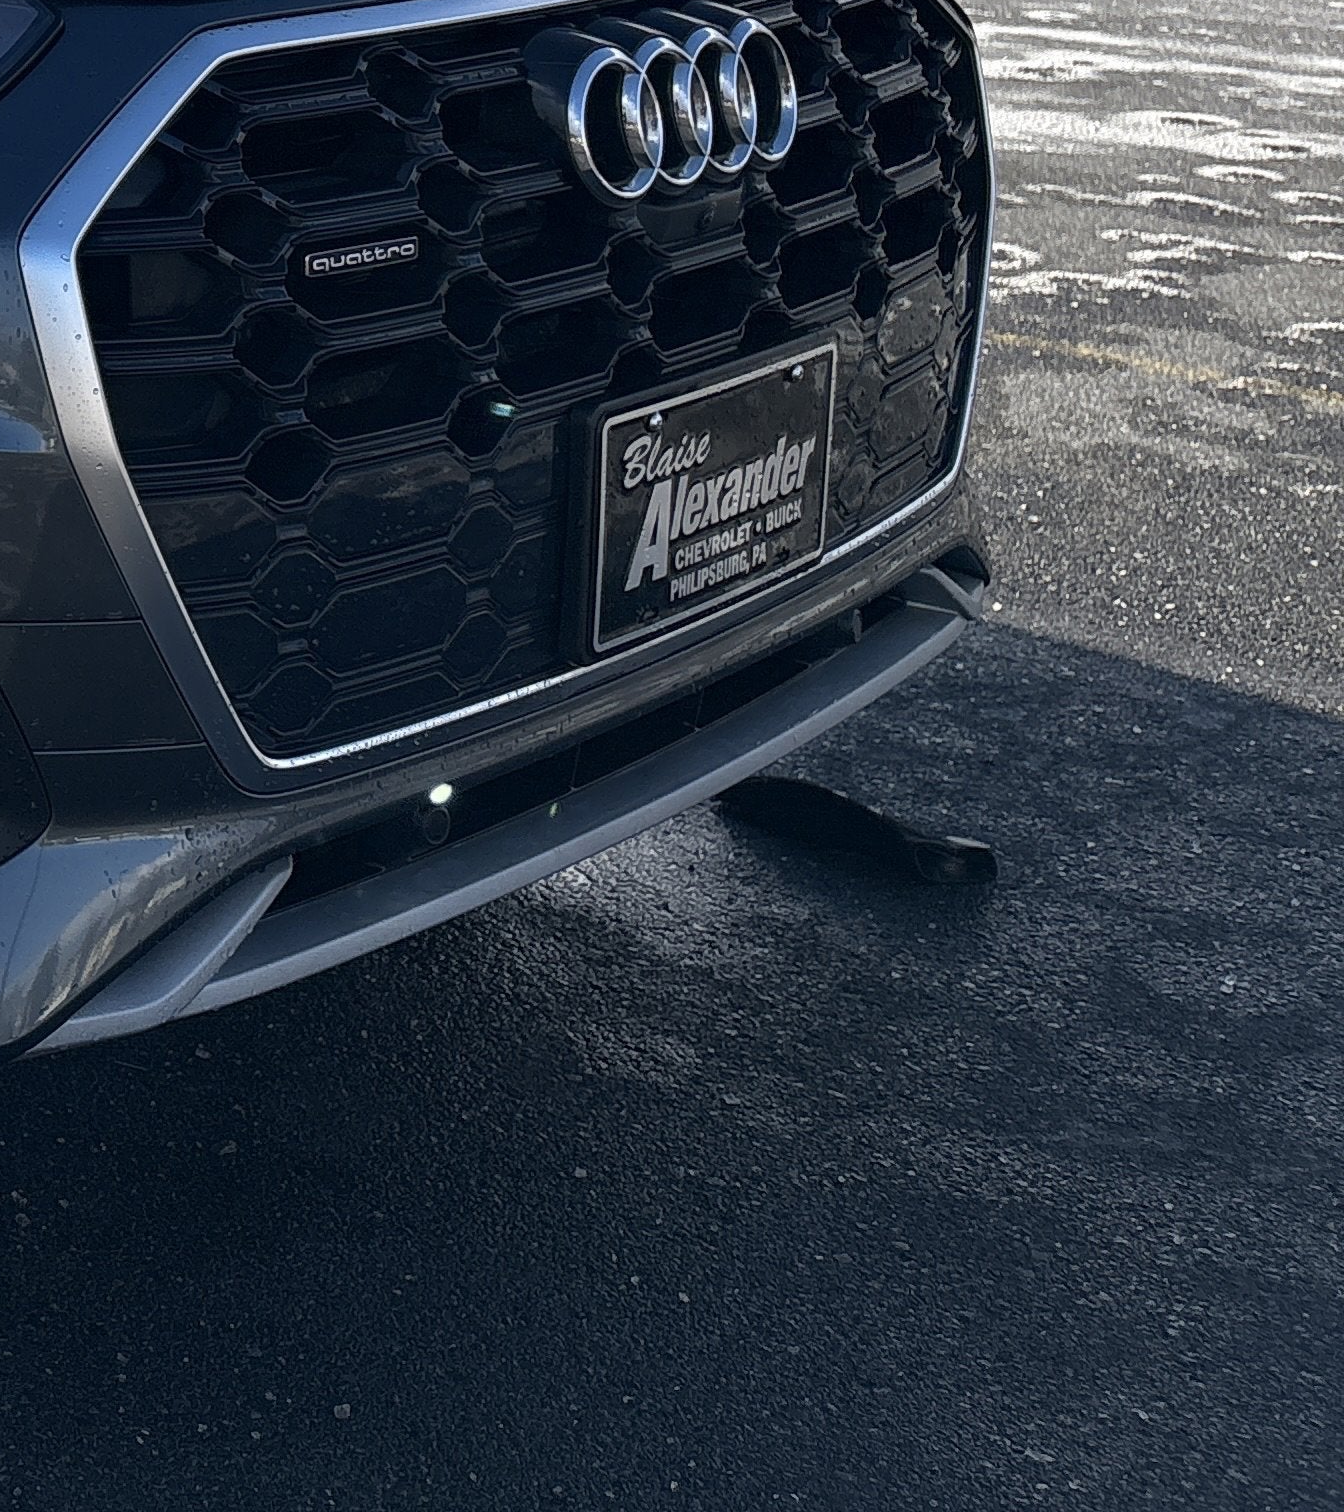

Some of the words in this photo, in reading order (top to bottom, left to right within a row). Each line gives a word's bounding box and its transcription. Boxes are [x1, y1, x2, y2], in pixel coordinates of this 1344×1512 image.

[312, 243, 415, 271] quattro
[623, 432, 711, 489] Blaise
[624, 435, 816, 592] Alexander
[674, 520, 752, 571] CHEVROLET
[765, 497, 803, 534] BUICK
[669, 551, 751, 602] PHILIPSBURG,
[751, 541, 768, 565] PA
